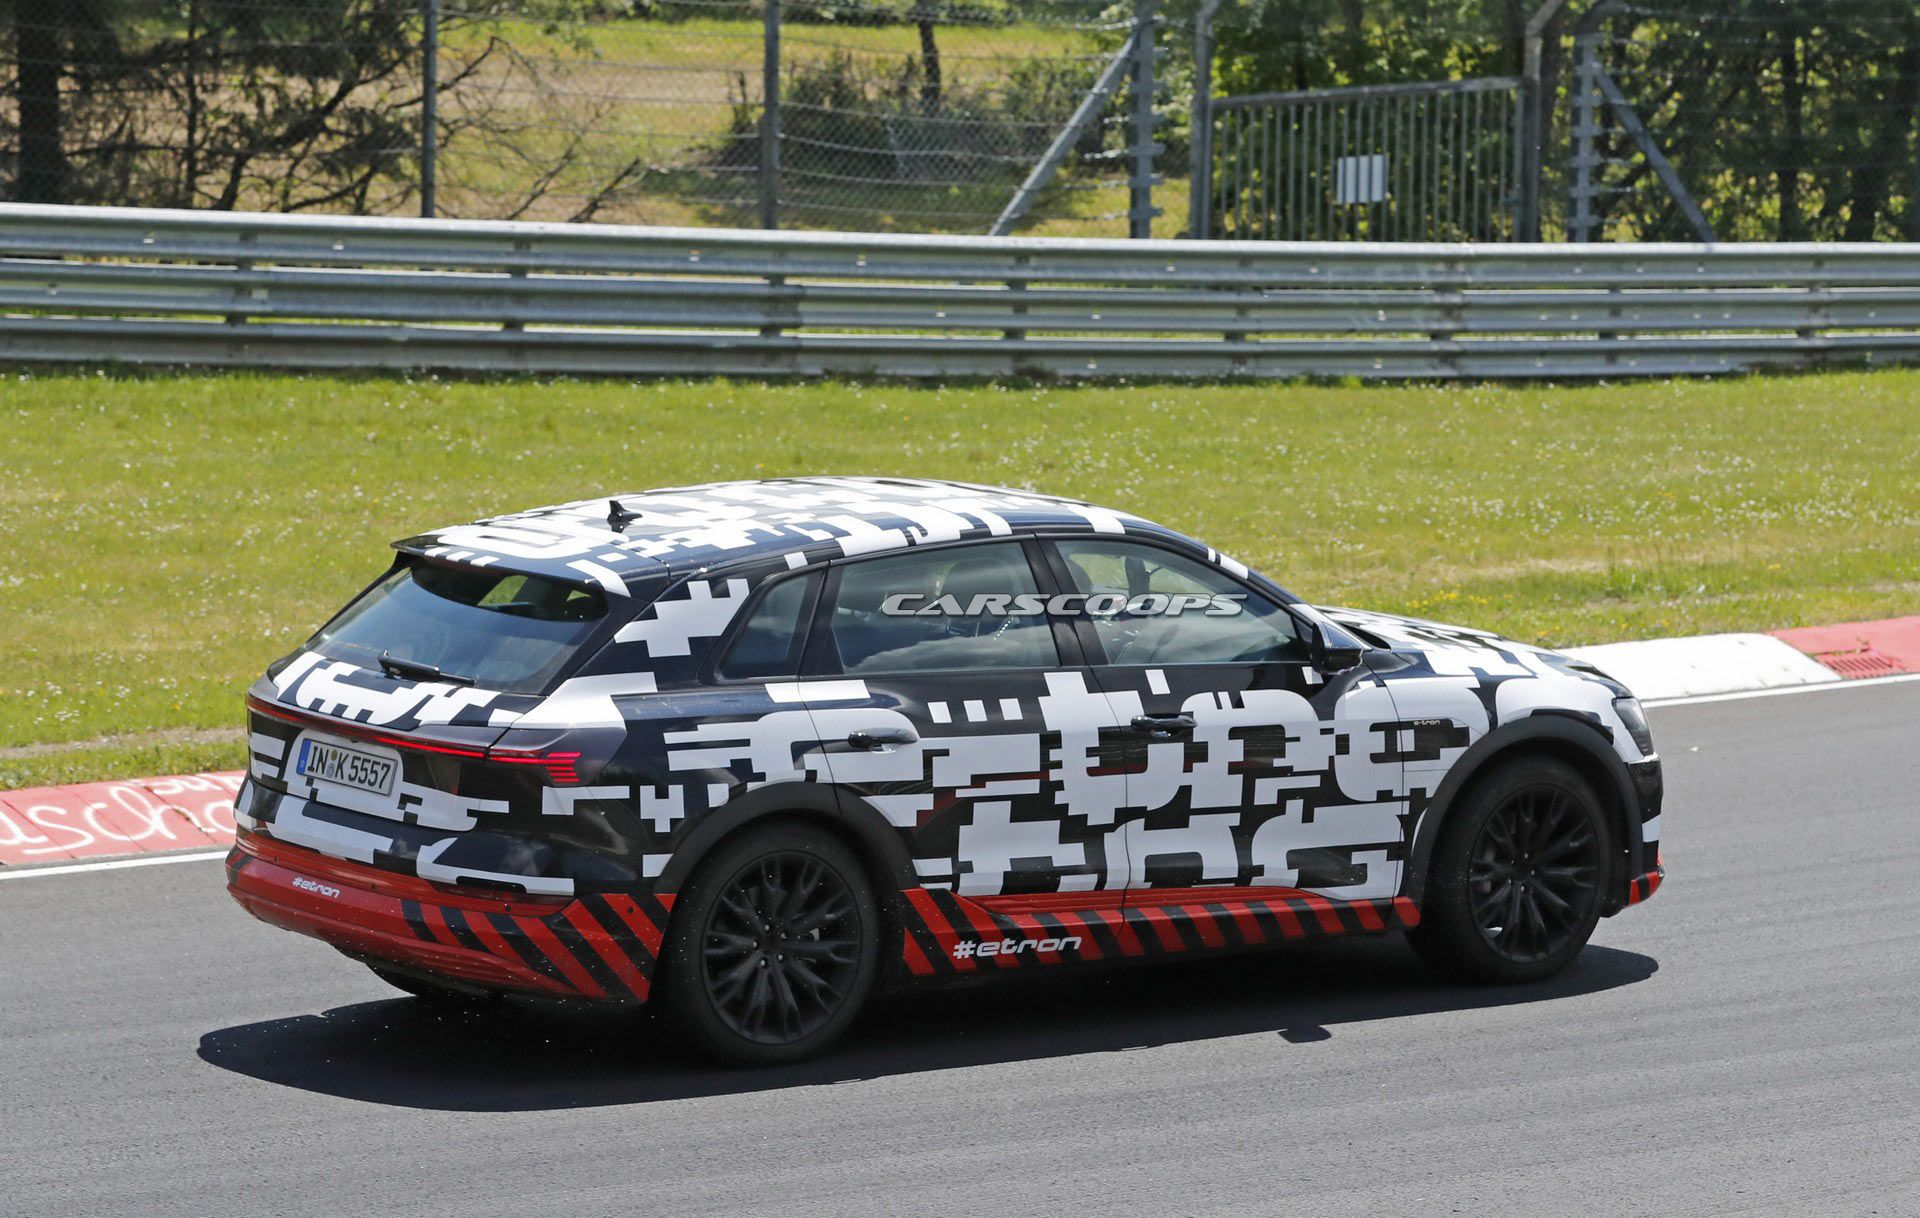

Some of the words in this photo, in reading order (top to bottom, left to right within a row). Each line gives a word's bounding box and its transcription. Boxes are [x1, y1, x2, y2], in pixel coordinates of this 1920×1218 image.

[307, 746, 329, 774] IN
[292, 876, 341, 898] #etron
[953, 936, 1082, 959] #etron
